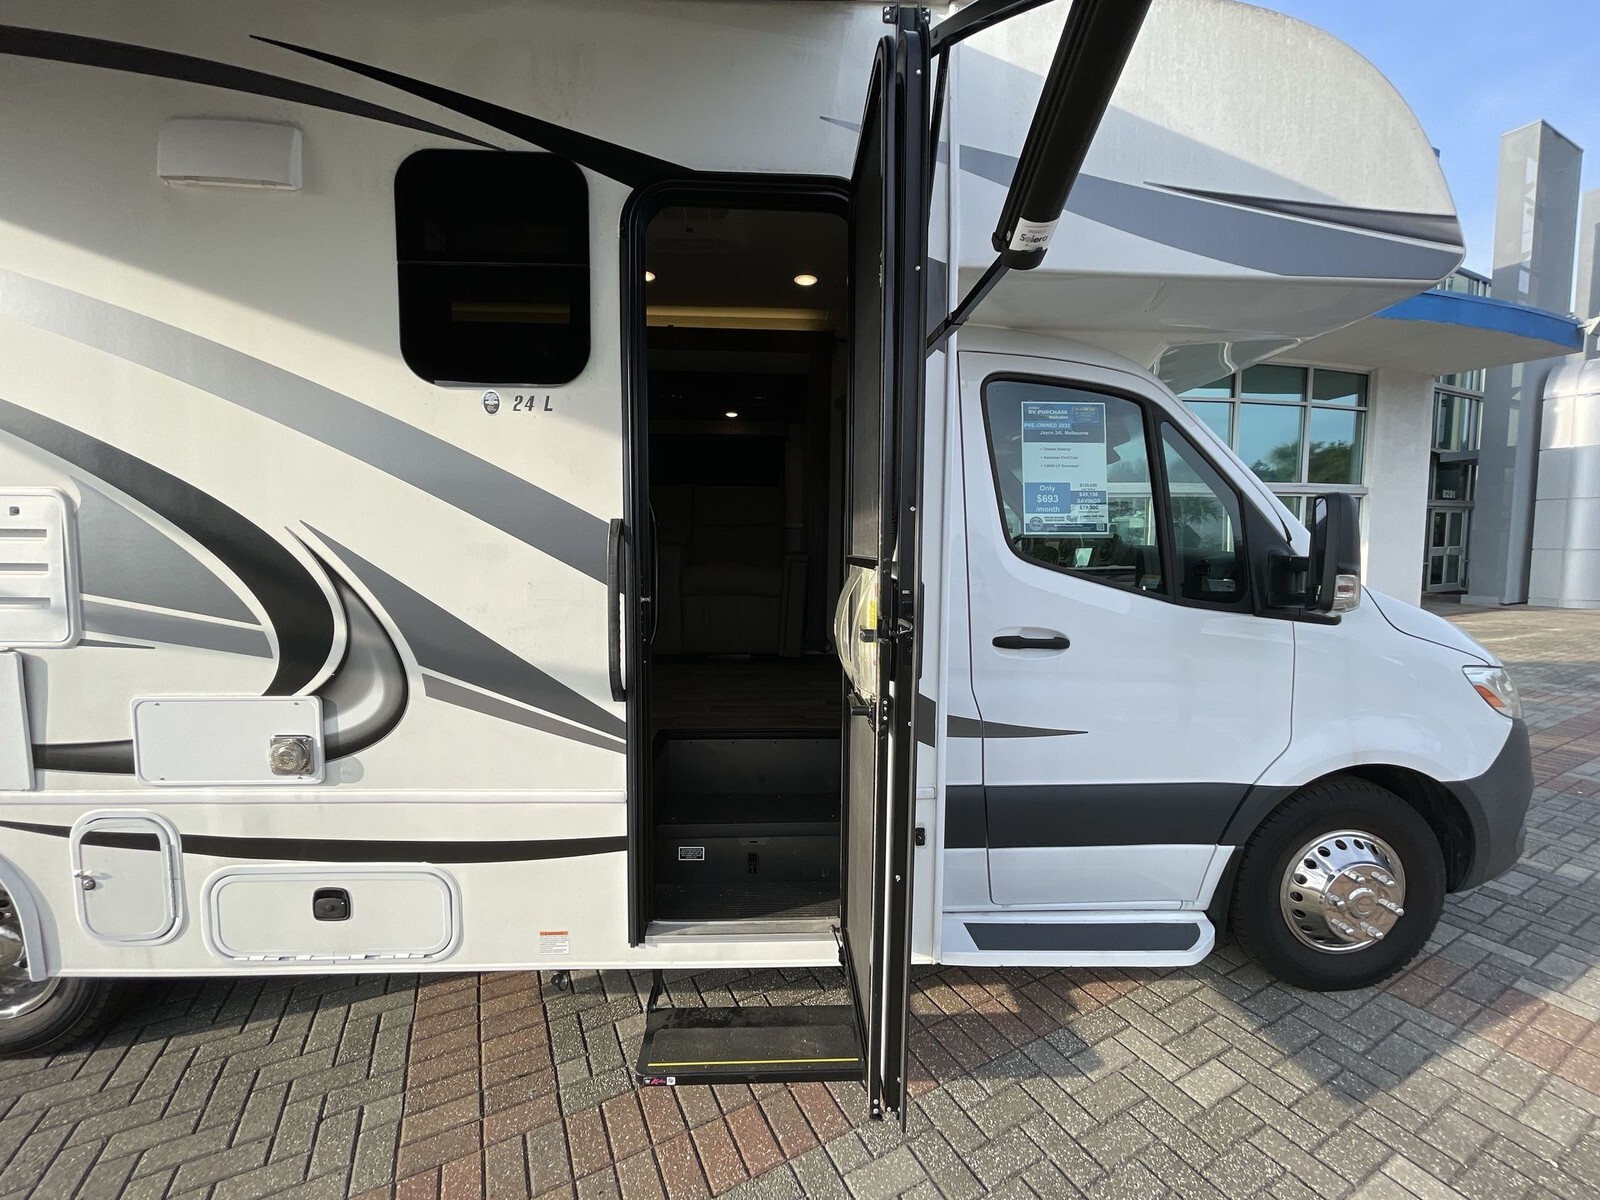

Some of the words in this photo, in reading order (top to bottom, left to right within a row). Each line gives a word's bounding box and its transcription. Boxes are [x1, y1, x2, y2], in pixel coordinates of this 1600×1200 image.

[513, 395, 535, 412] 24
[544, 396, 553, 412] L
[1040, 485, 1055, 493] Only
[1036, 494, 1059, 503] $693
